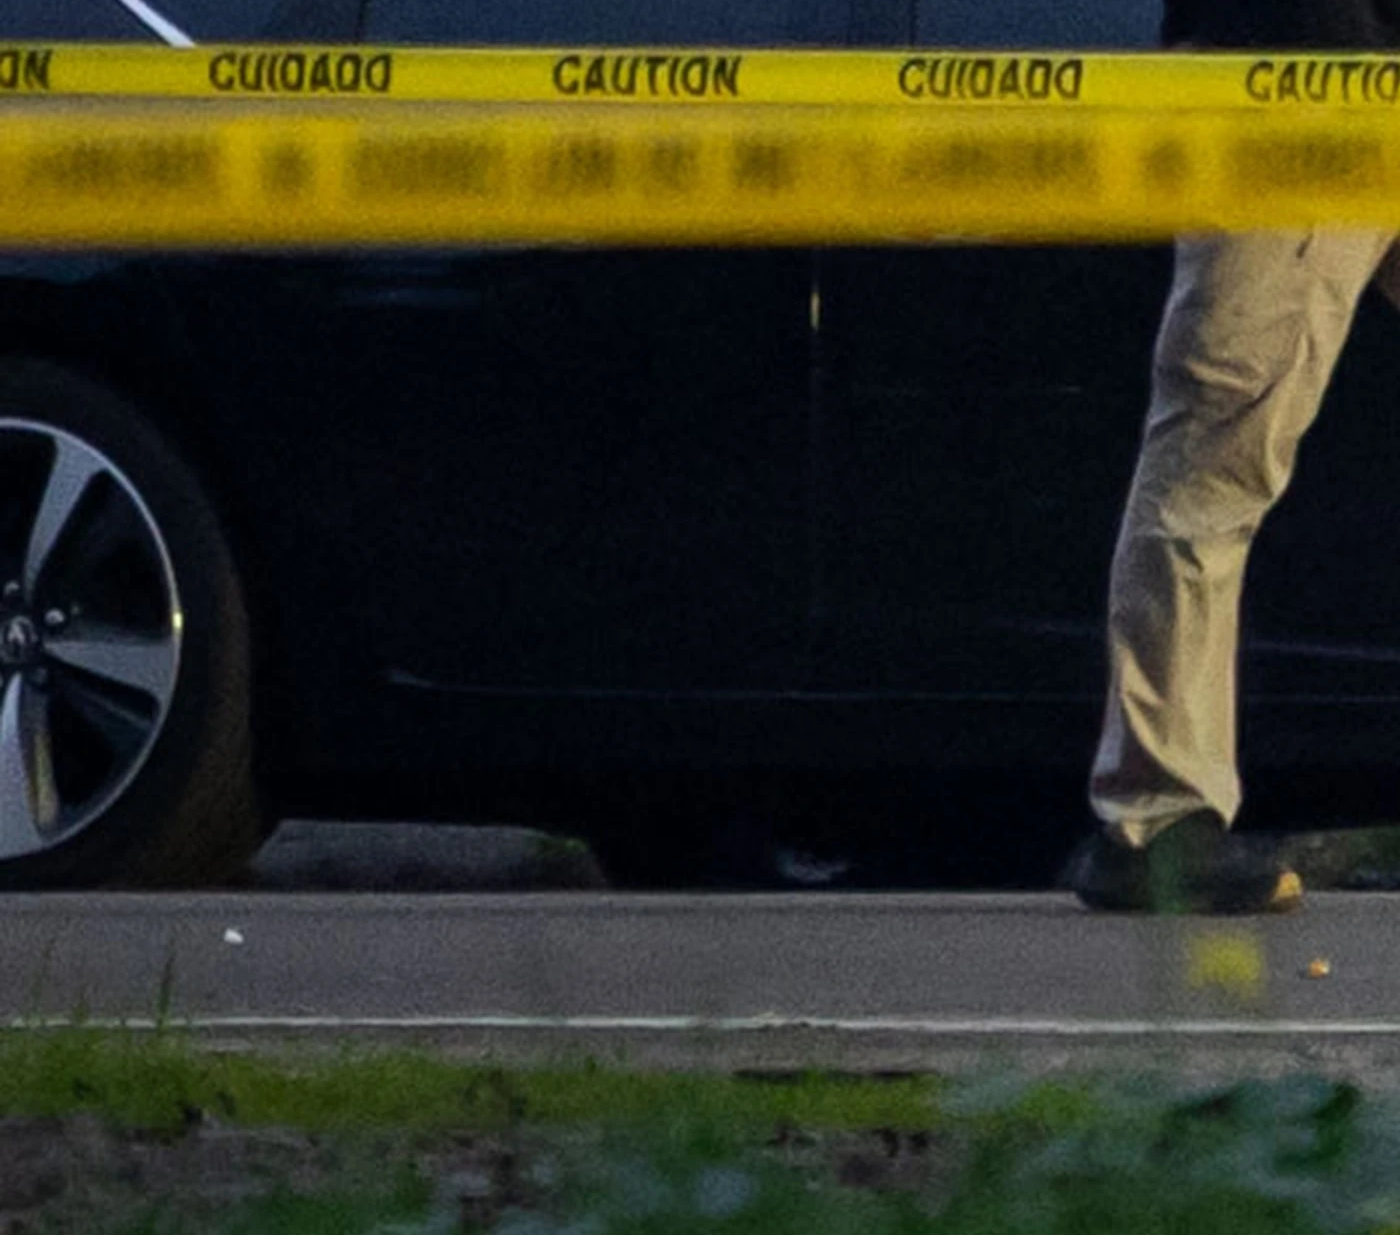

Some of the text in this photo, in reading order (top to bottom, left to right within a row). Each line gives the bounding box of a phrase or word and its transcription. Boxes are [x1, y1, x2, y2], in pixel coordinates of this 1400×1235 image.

[208, 52, 391, 92] CUIDADO
[552, 55, 742, 96] CAUTION
[898, 56, 1083, 100] CUIDADO
